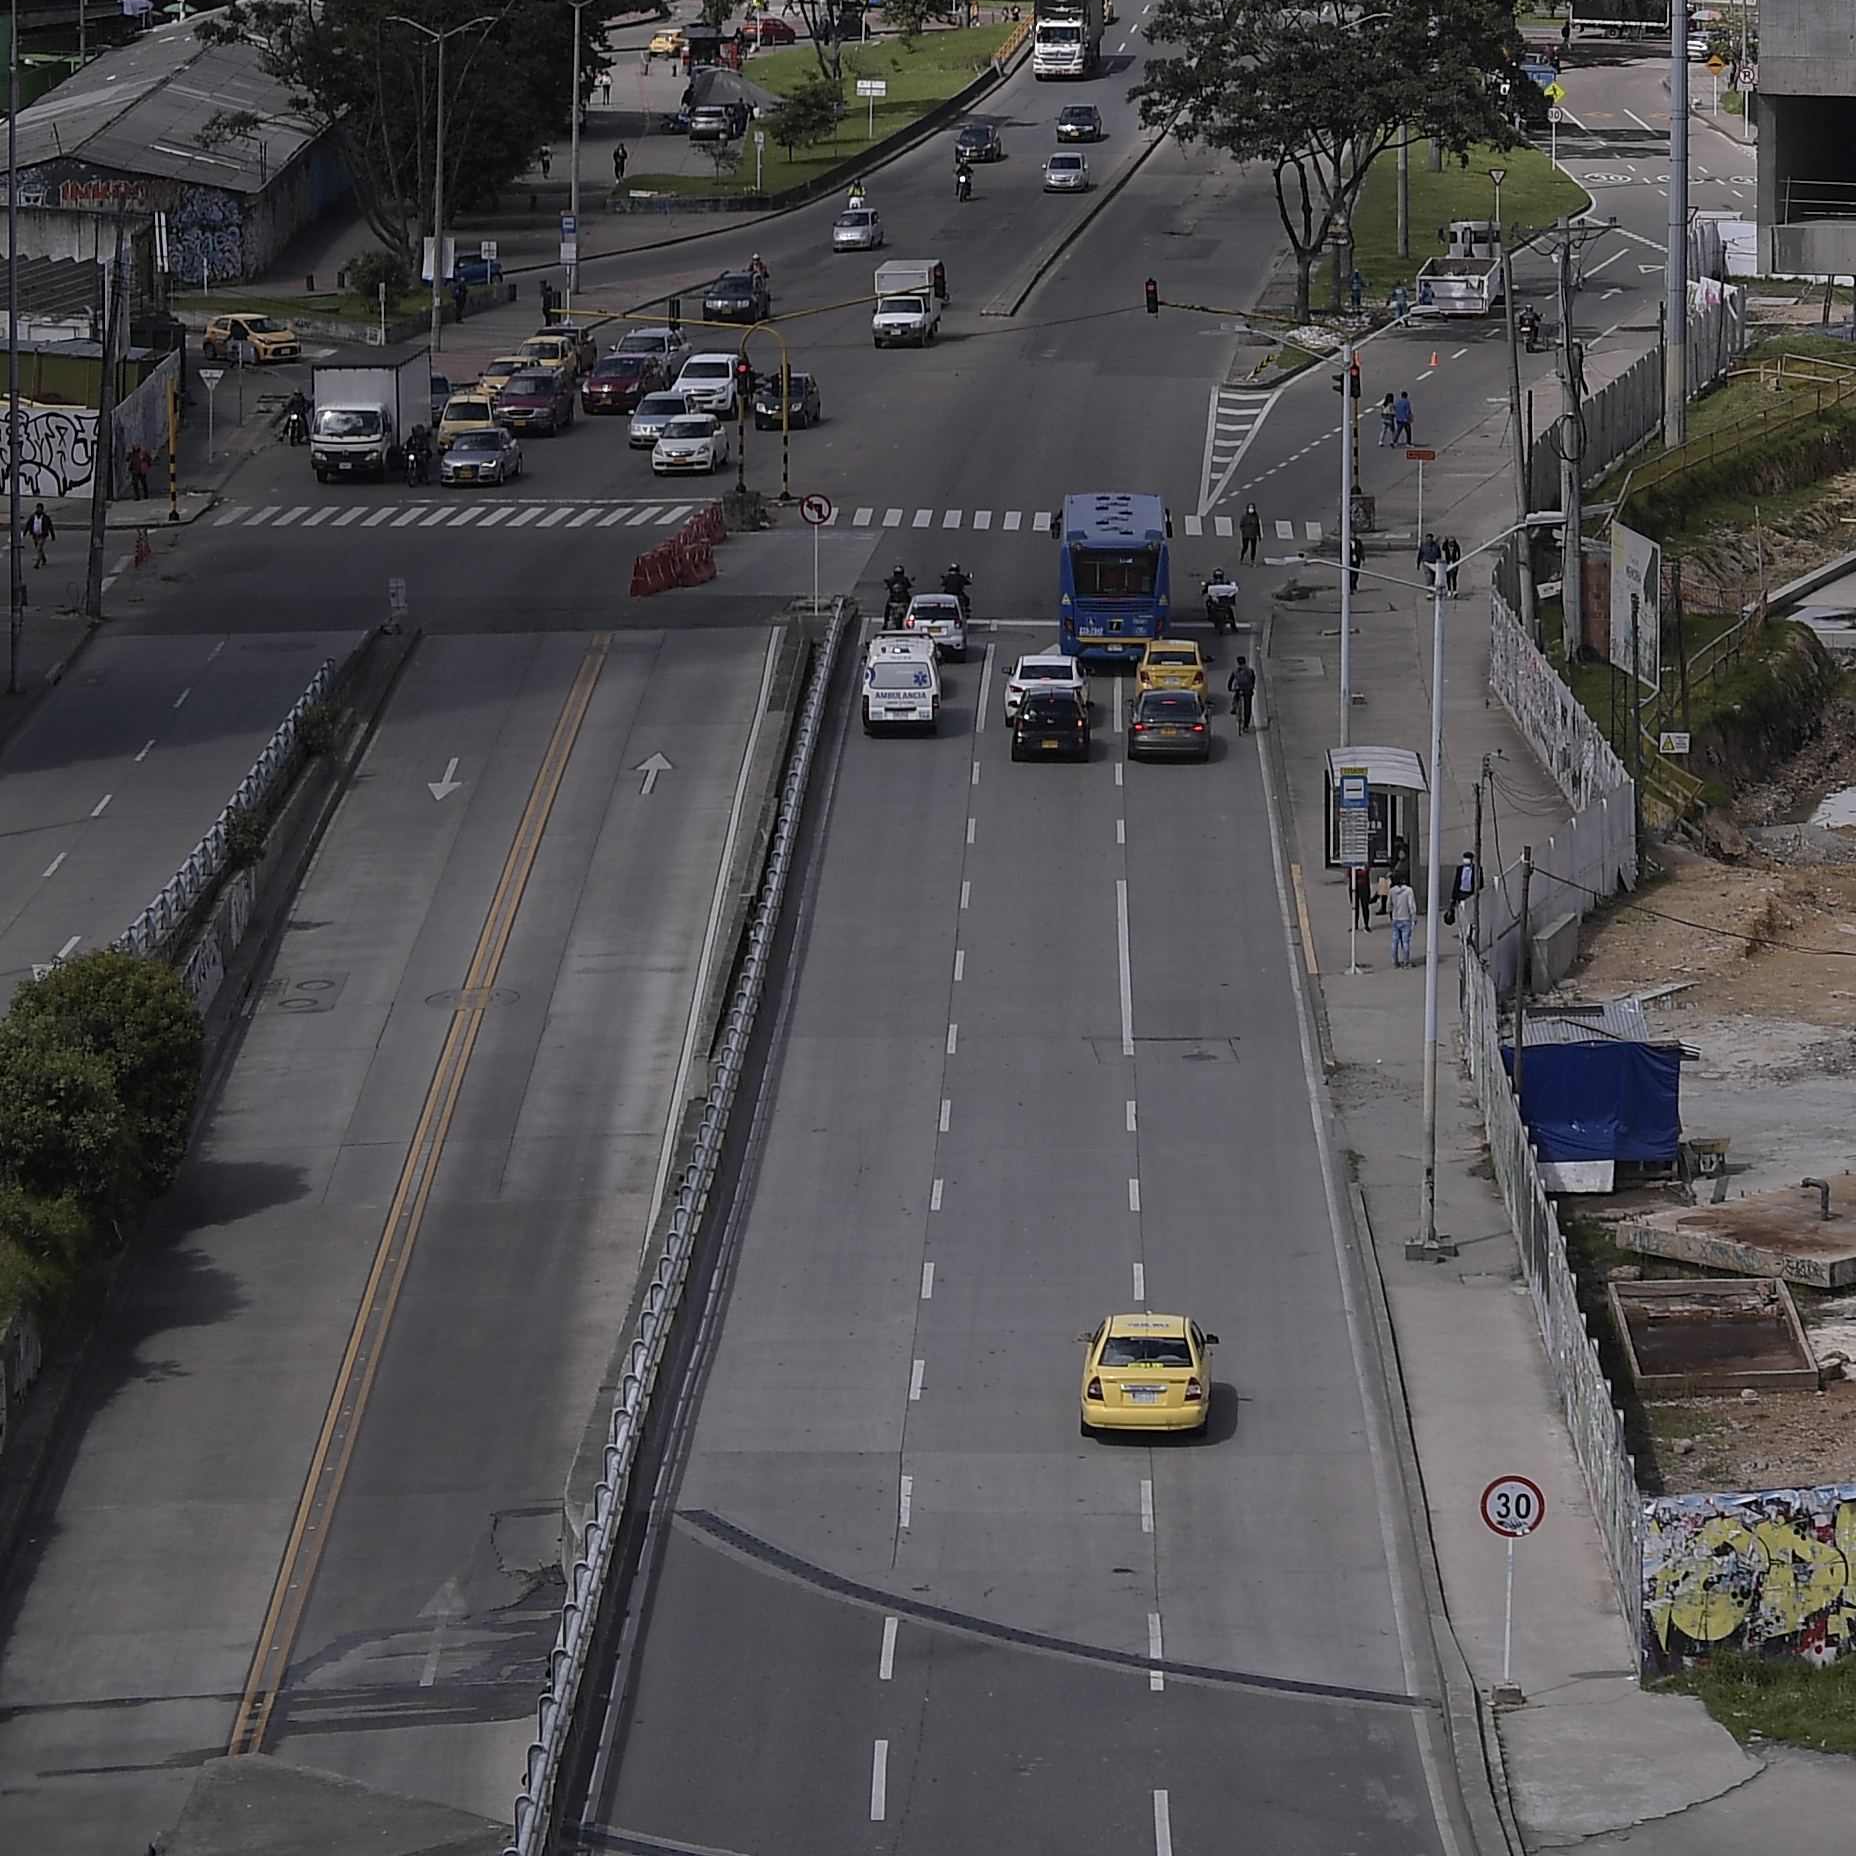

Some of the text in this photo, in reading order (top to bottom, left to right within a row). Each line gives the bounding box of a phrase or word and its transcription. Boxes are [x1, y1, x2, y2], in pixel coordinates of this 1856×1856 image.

[1550, 110, 1560, 119] 30
[874, 691, 927, 700] AMBULANCIA
[1496, 1492, 1531, 1519] 30
